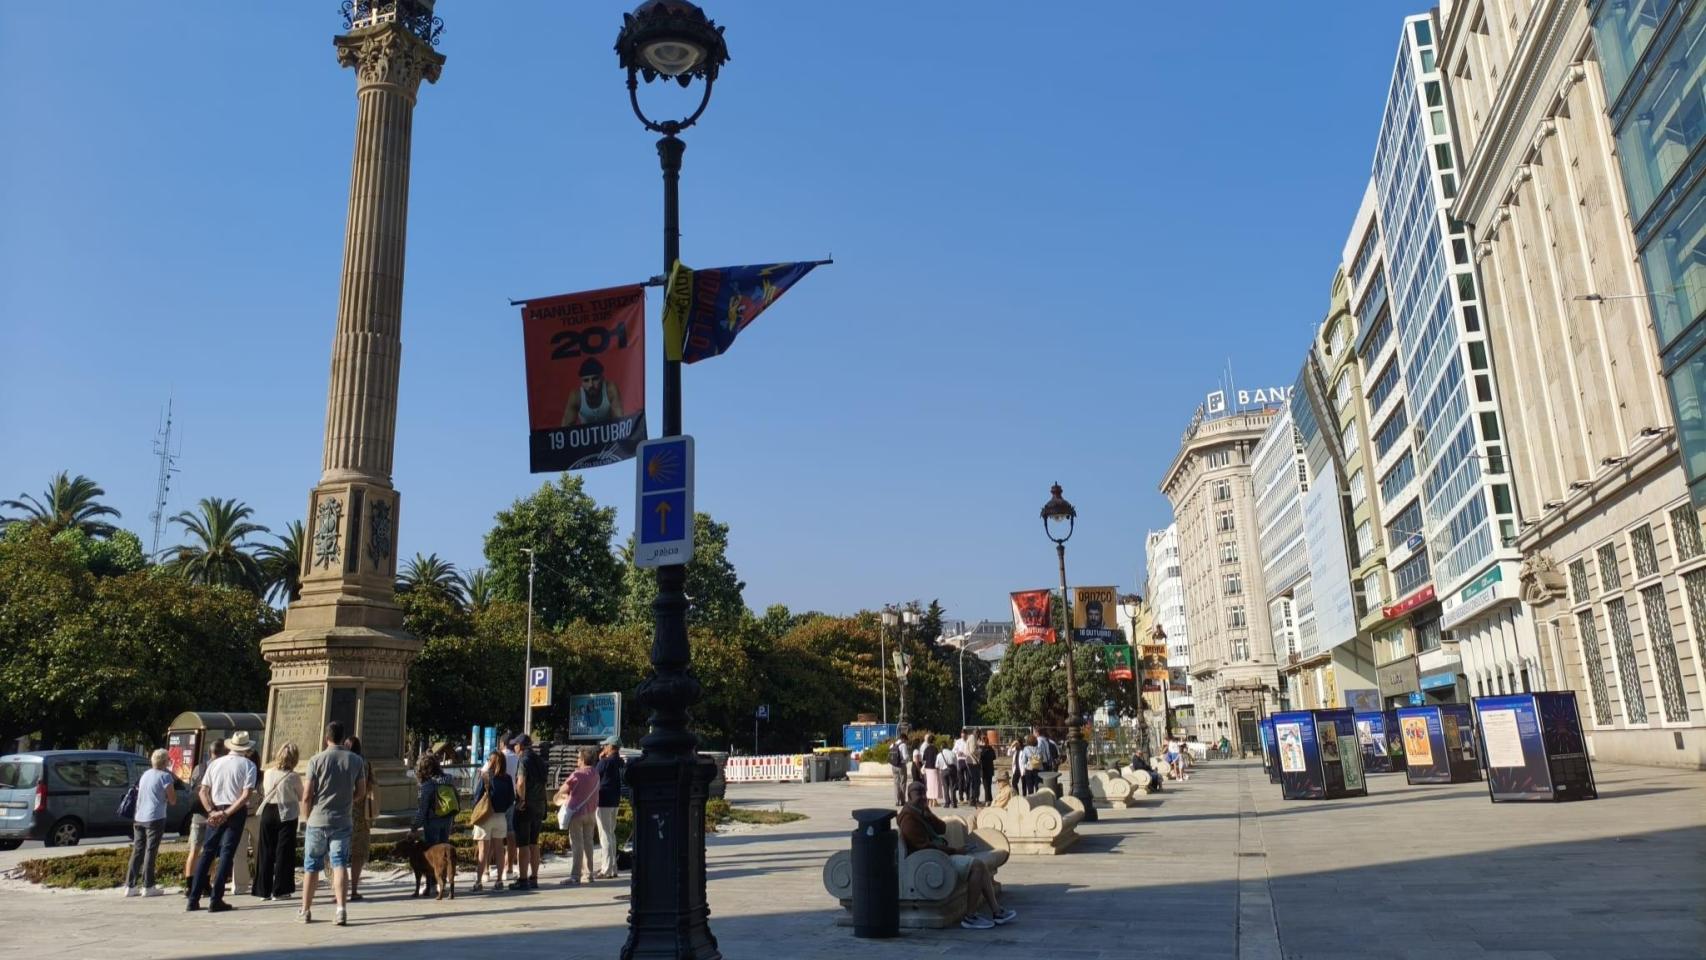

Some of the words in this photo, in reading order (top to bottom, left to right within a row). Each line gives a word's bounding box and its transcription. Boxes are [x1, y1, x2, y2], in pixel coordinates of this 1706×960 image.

[529, 303, 584, 320] MANUEL
[550, 321, 628, 359] 201
[548, 431, 565, 450] 19
[570, 418, 633, 448] OUTUBRO
[1078, 591, 1112, 604] OROZCO
[535, 670, 544, 686] P
